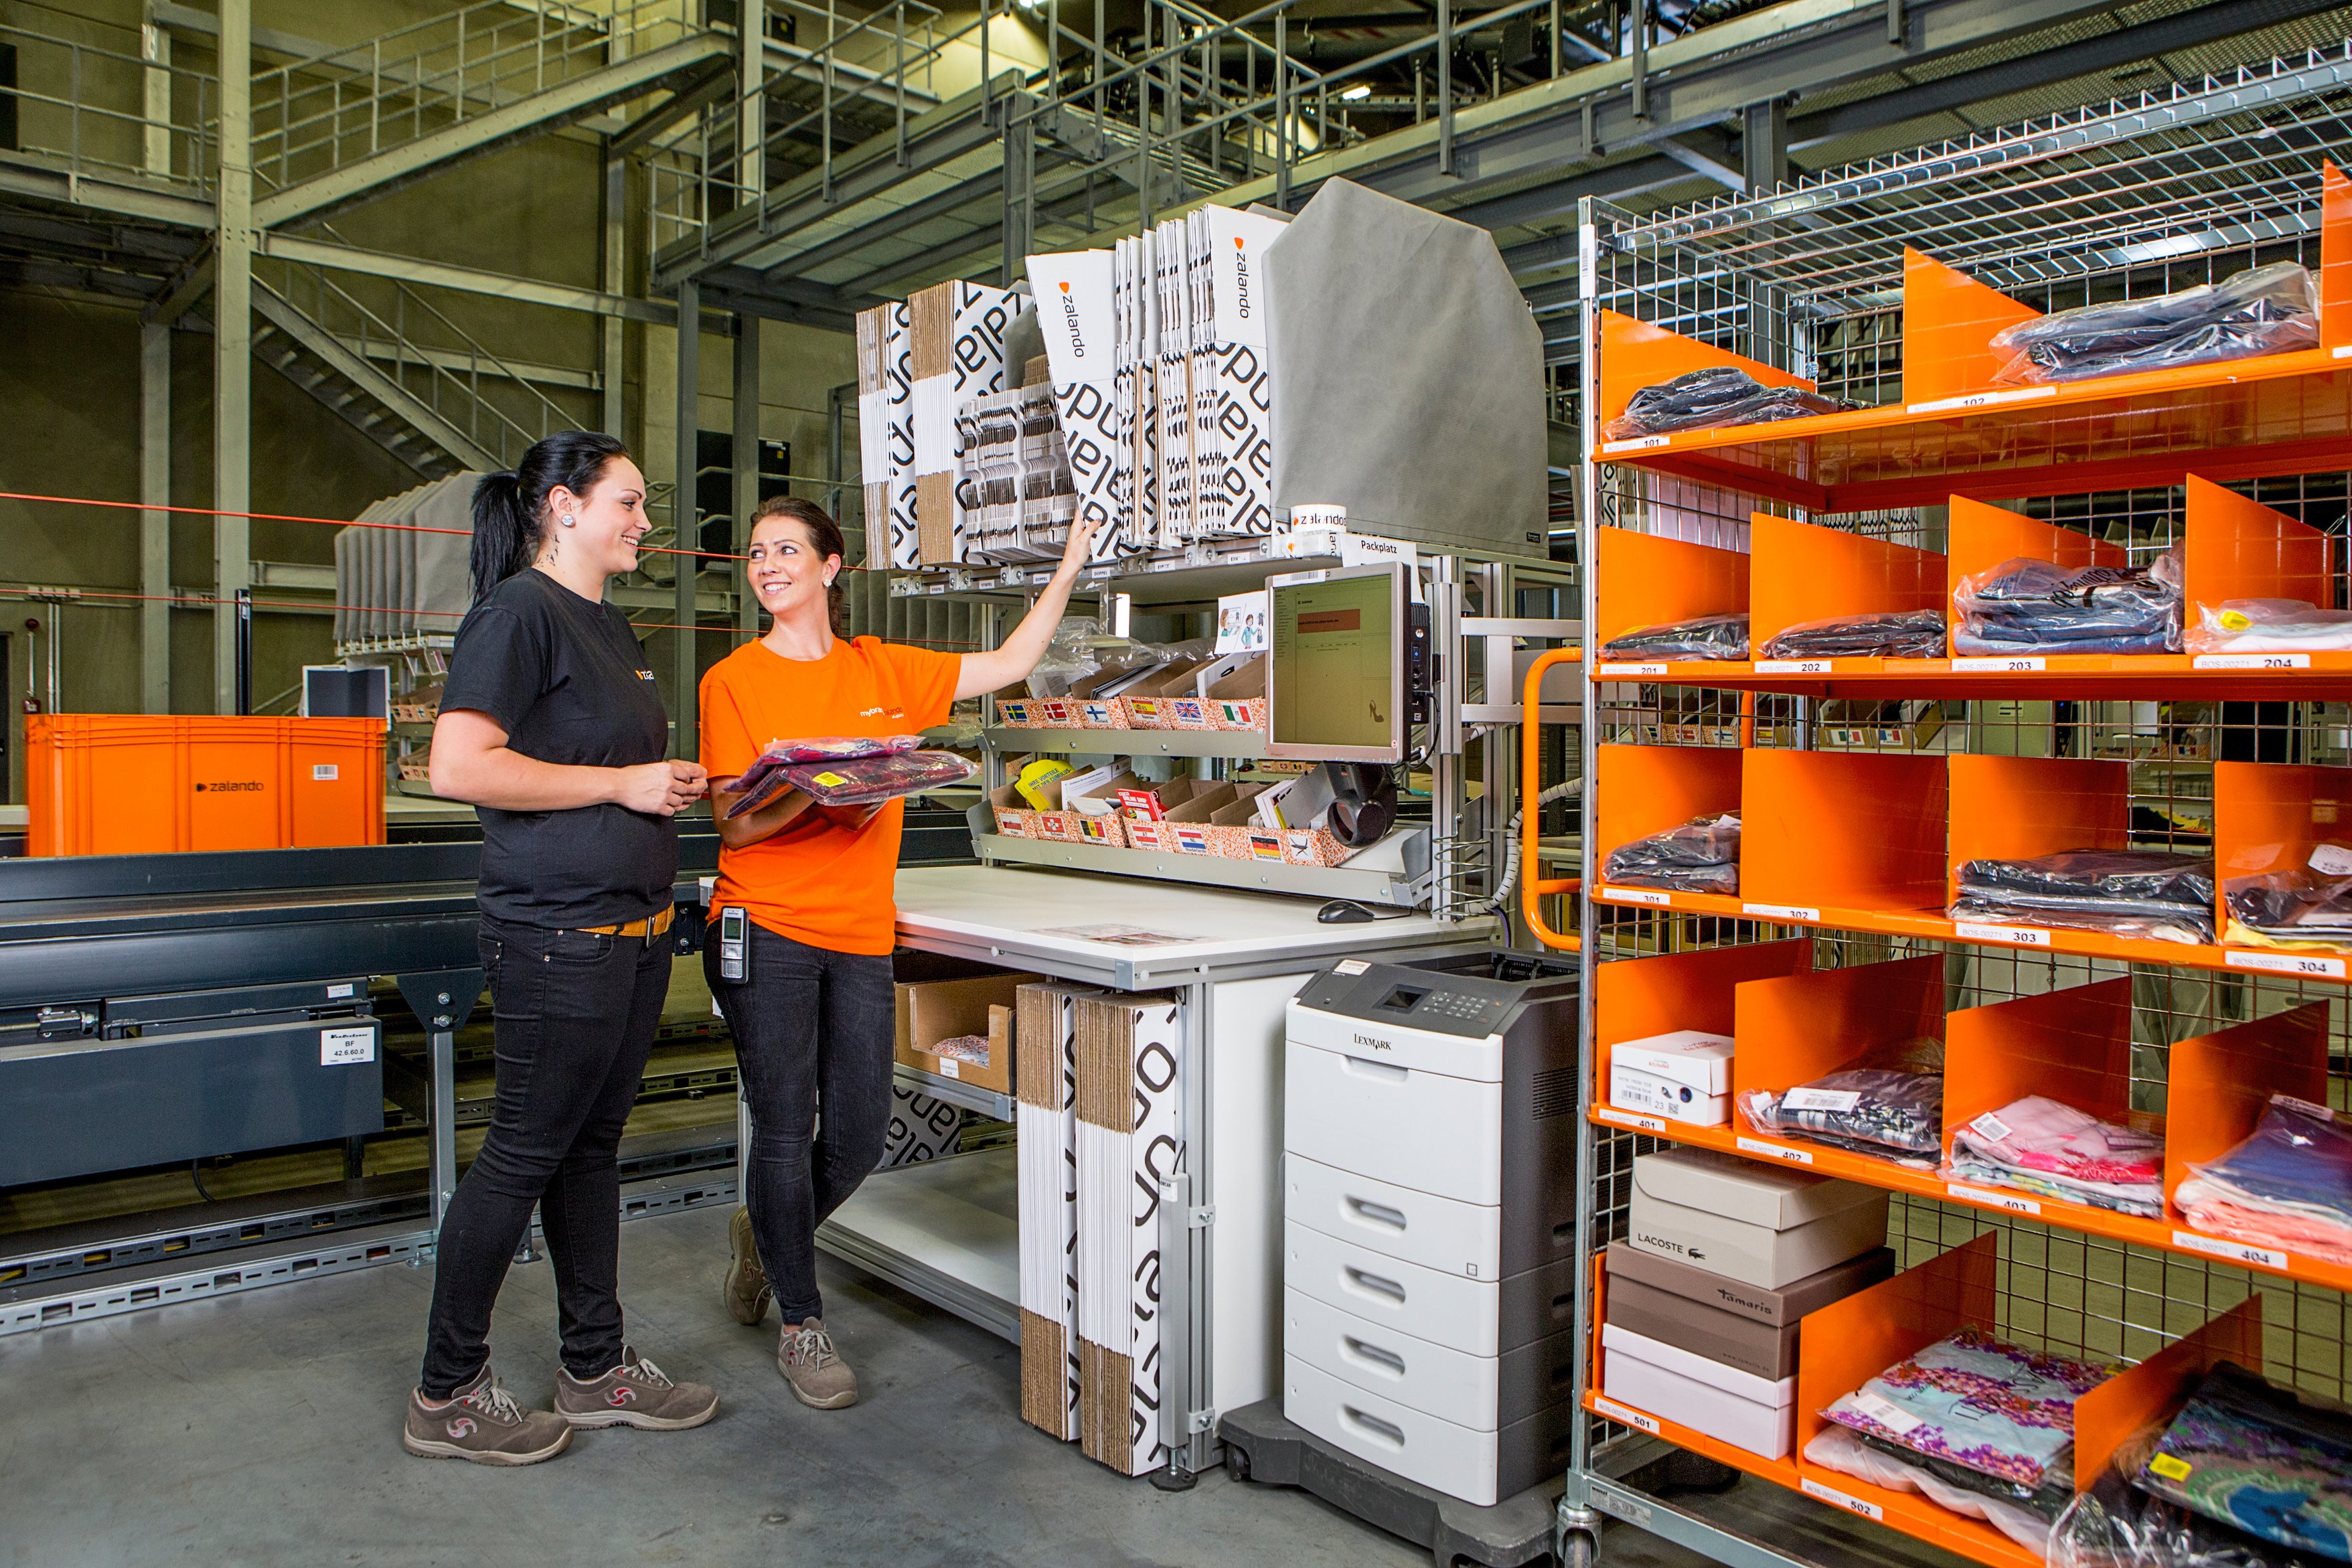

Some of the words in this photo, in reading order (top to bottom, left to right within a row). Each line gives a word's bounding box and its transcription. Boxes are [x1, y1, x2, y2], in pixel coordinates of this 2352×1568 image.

[1236, 252, 1251, 319] zalando
[1063, 295, 1085, 358] zalando
[1644, 439, 1659, 447] 101
[1361, 540, 1397, 554] Packplatz
[1801, 663, 1820, 672] 202
[2009, 661, 2031, 670] 203
[2264, 659, 2292, 668] 204
[1038, 768, 1059, 781] VORTEILE
[210, 780, 264, 791] zalando
[1644, 895, 1660, 903] 301
[1790, 911, 1808, 919] 302
[2013, 932, 2036, 942] 303
[2297, 961, 2327, 973] 304
[1354, 1033, 1392, 1050] LEXMARK
[1654, 1101, 1664, 1110] 23
[1640, 1120, 1655, 1130] 401
[1783, 1152, 1801, 1162] 402
[2005, 1200, 2027, 1211] 403
[1638, 1233, 1683, 1253] LACOSTE
[2242, 1250, 2270, 1263] 404
[1717, 1289, 1772, 1315] Tamaris
[1634, 1415, 1650, 1428] 501
[1849, 1500, 1869, 1515] 502
